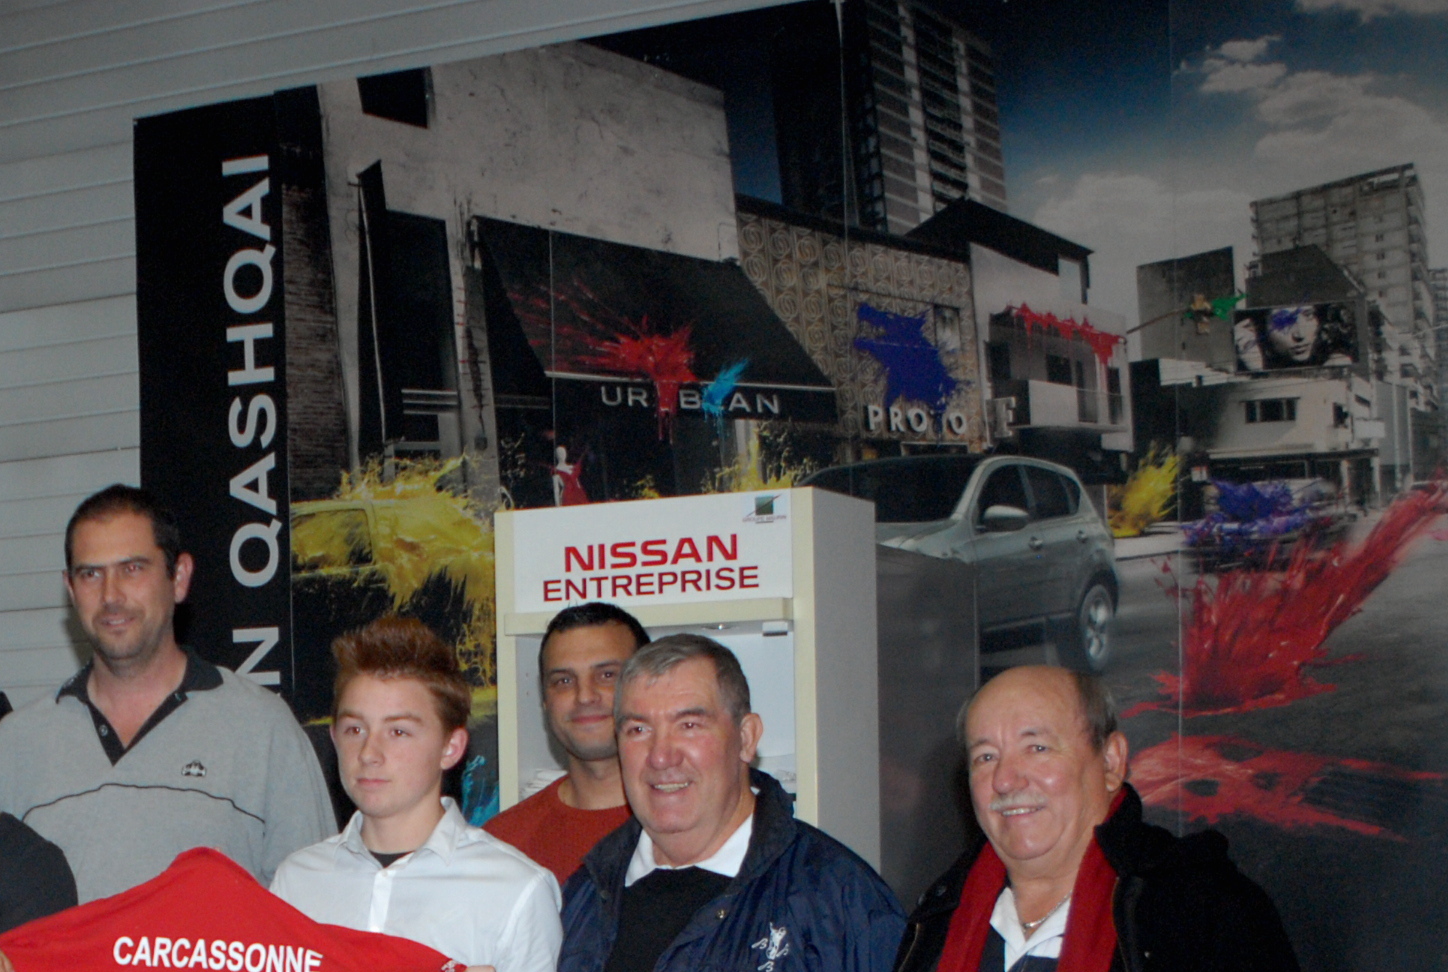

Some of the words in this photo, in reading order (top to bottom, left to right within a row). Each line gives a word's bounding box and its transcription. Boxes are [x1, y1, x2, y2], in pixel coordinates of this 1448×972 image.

[221, 154, 282, 588] QASHQAI
[601, 385, 781, 414] URBAN
[564, 533, 738, 572] NISSAN
[543, 565, 760, 602] ENTREPRISE
